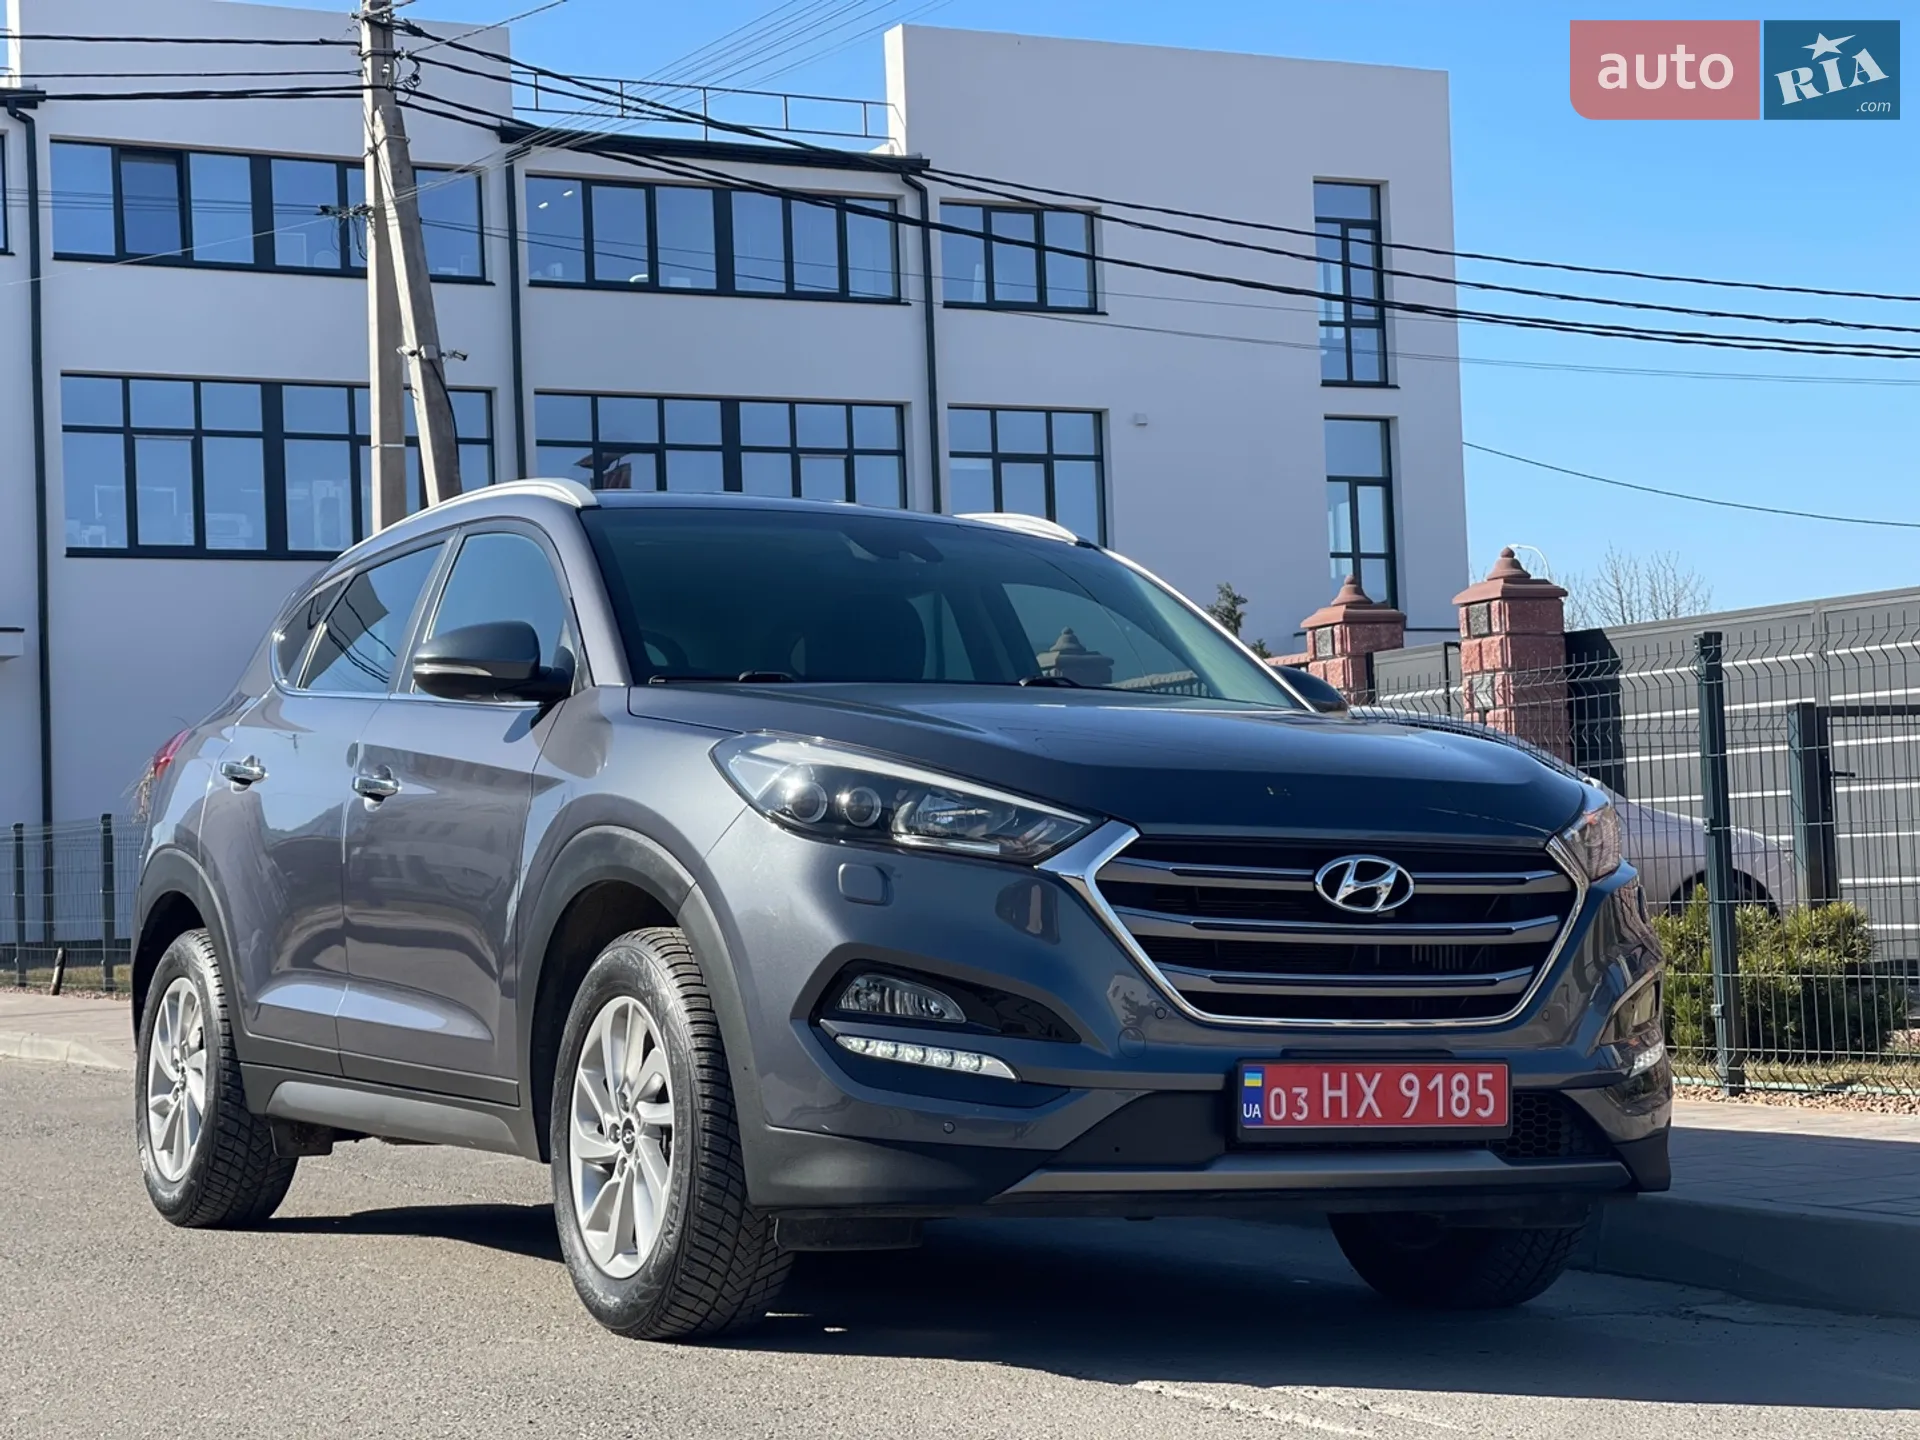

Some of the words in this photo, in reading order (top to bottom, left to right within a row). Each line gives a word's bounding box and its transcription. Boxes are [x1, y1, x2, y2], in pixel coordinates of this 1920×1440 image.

[1243, 1102, 1262, 1119] UA
[1269, 1087, 1309, 1121] 03
[1322, 1072, 1383, 1118] HX
[1400, 1072, 1495, 1119] 9185
